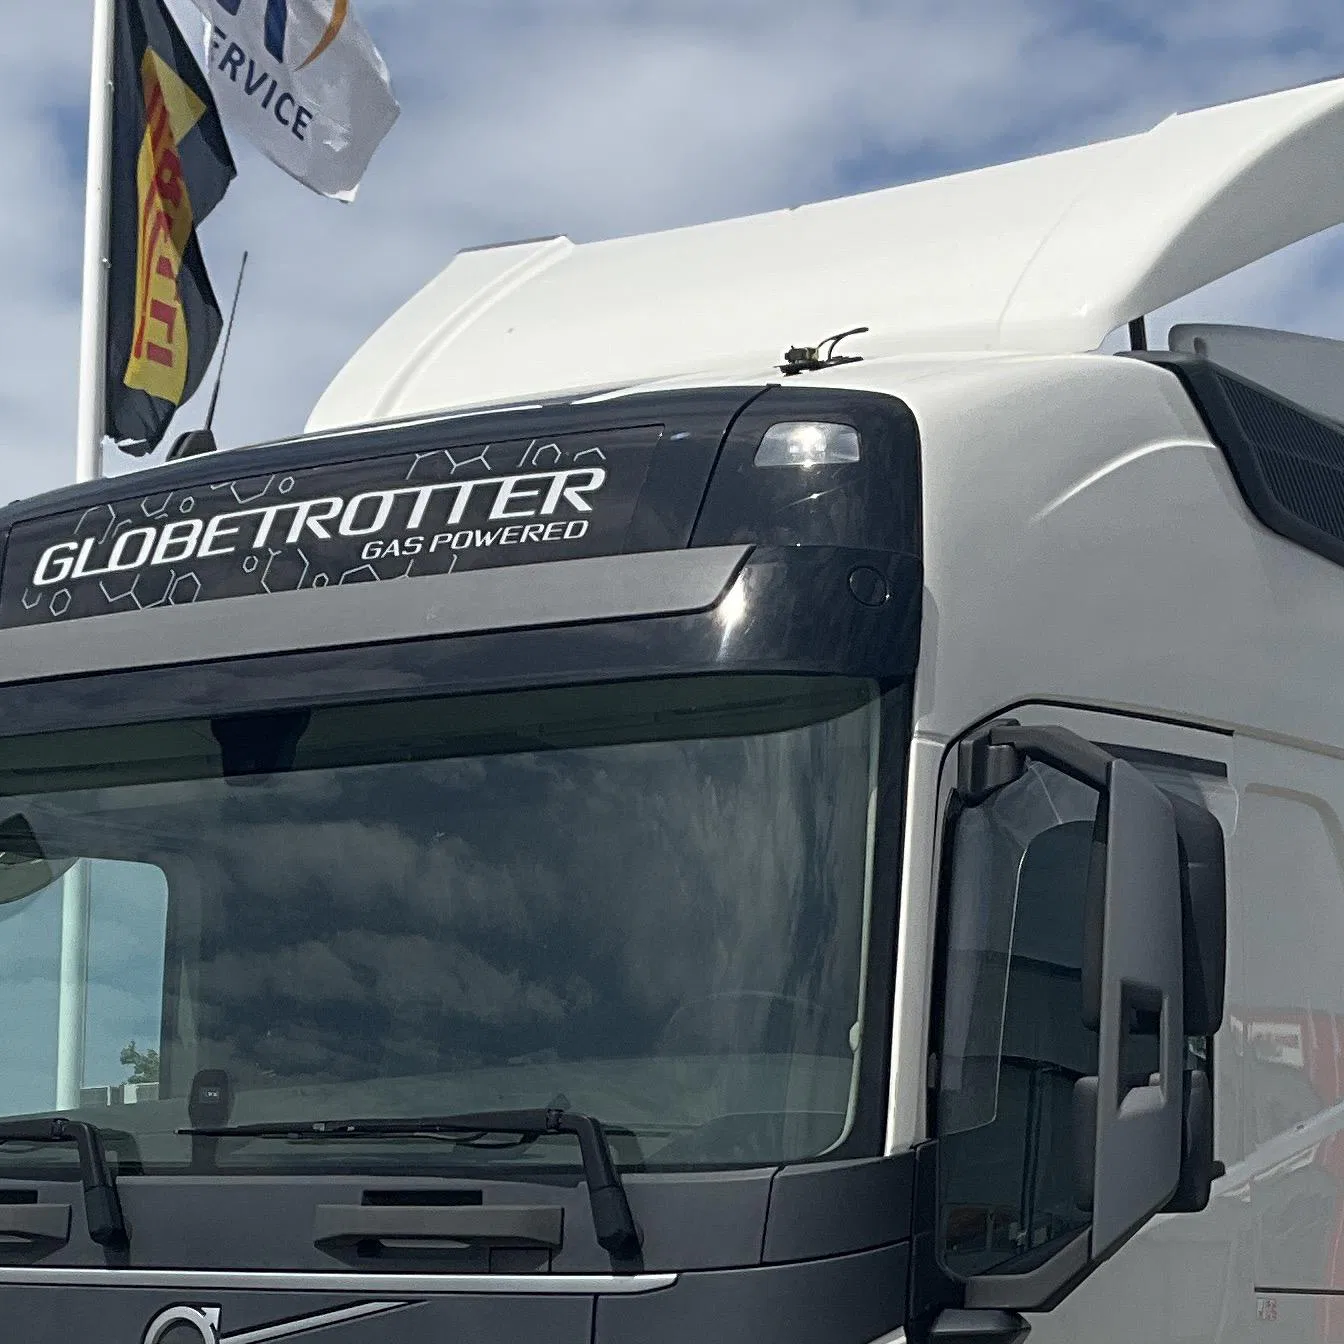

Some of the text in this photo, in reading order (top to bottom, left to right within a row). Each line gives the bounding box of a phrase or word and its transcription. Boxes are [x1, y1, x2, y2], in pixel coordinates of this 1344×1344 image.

[209, 23, 314, 142] ERVICE
[32, 467, 607, 587] GLOBETROTTER
[360, 519, 590, 561] GAS POWERED
